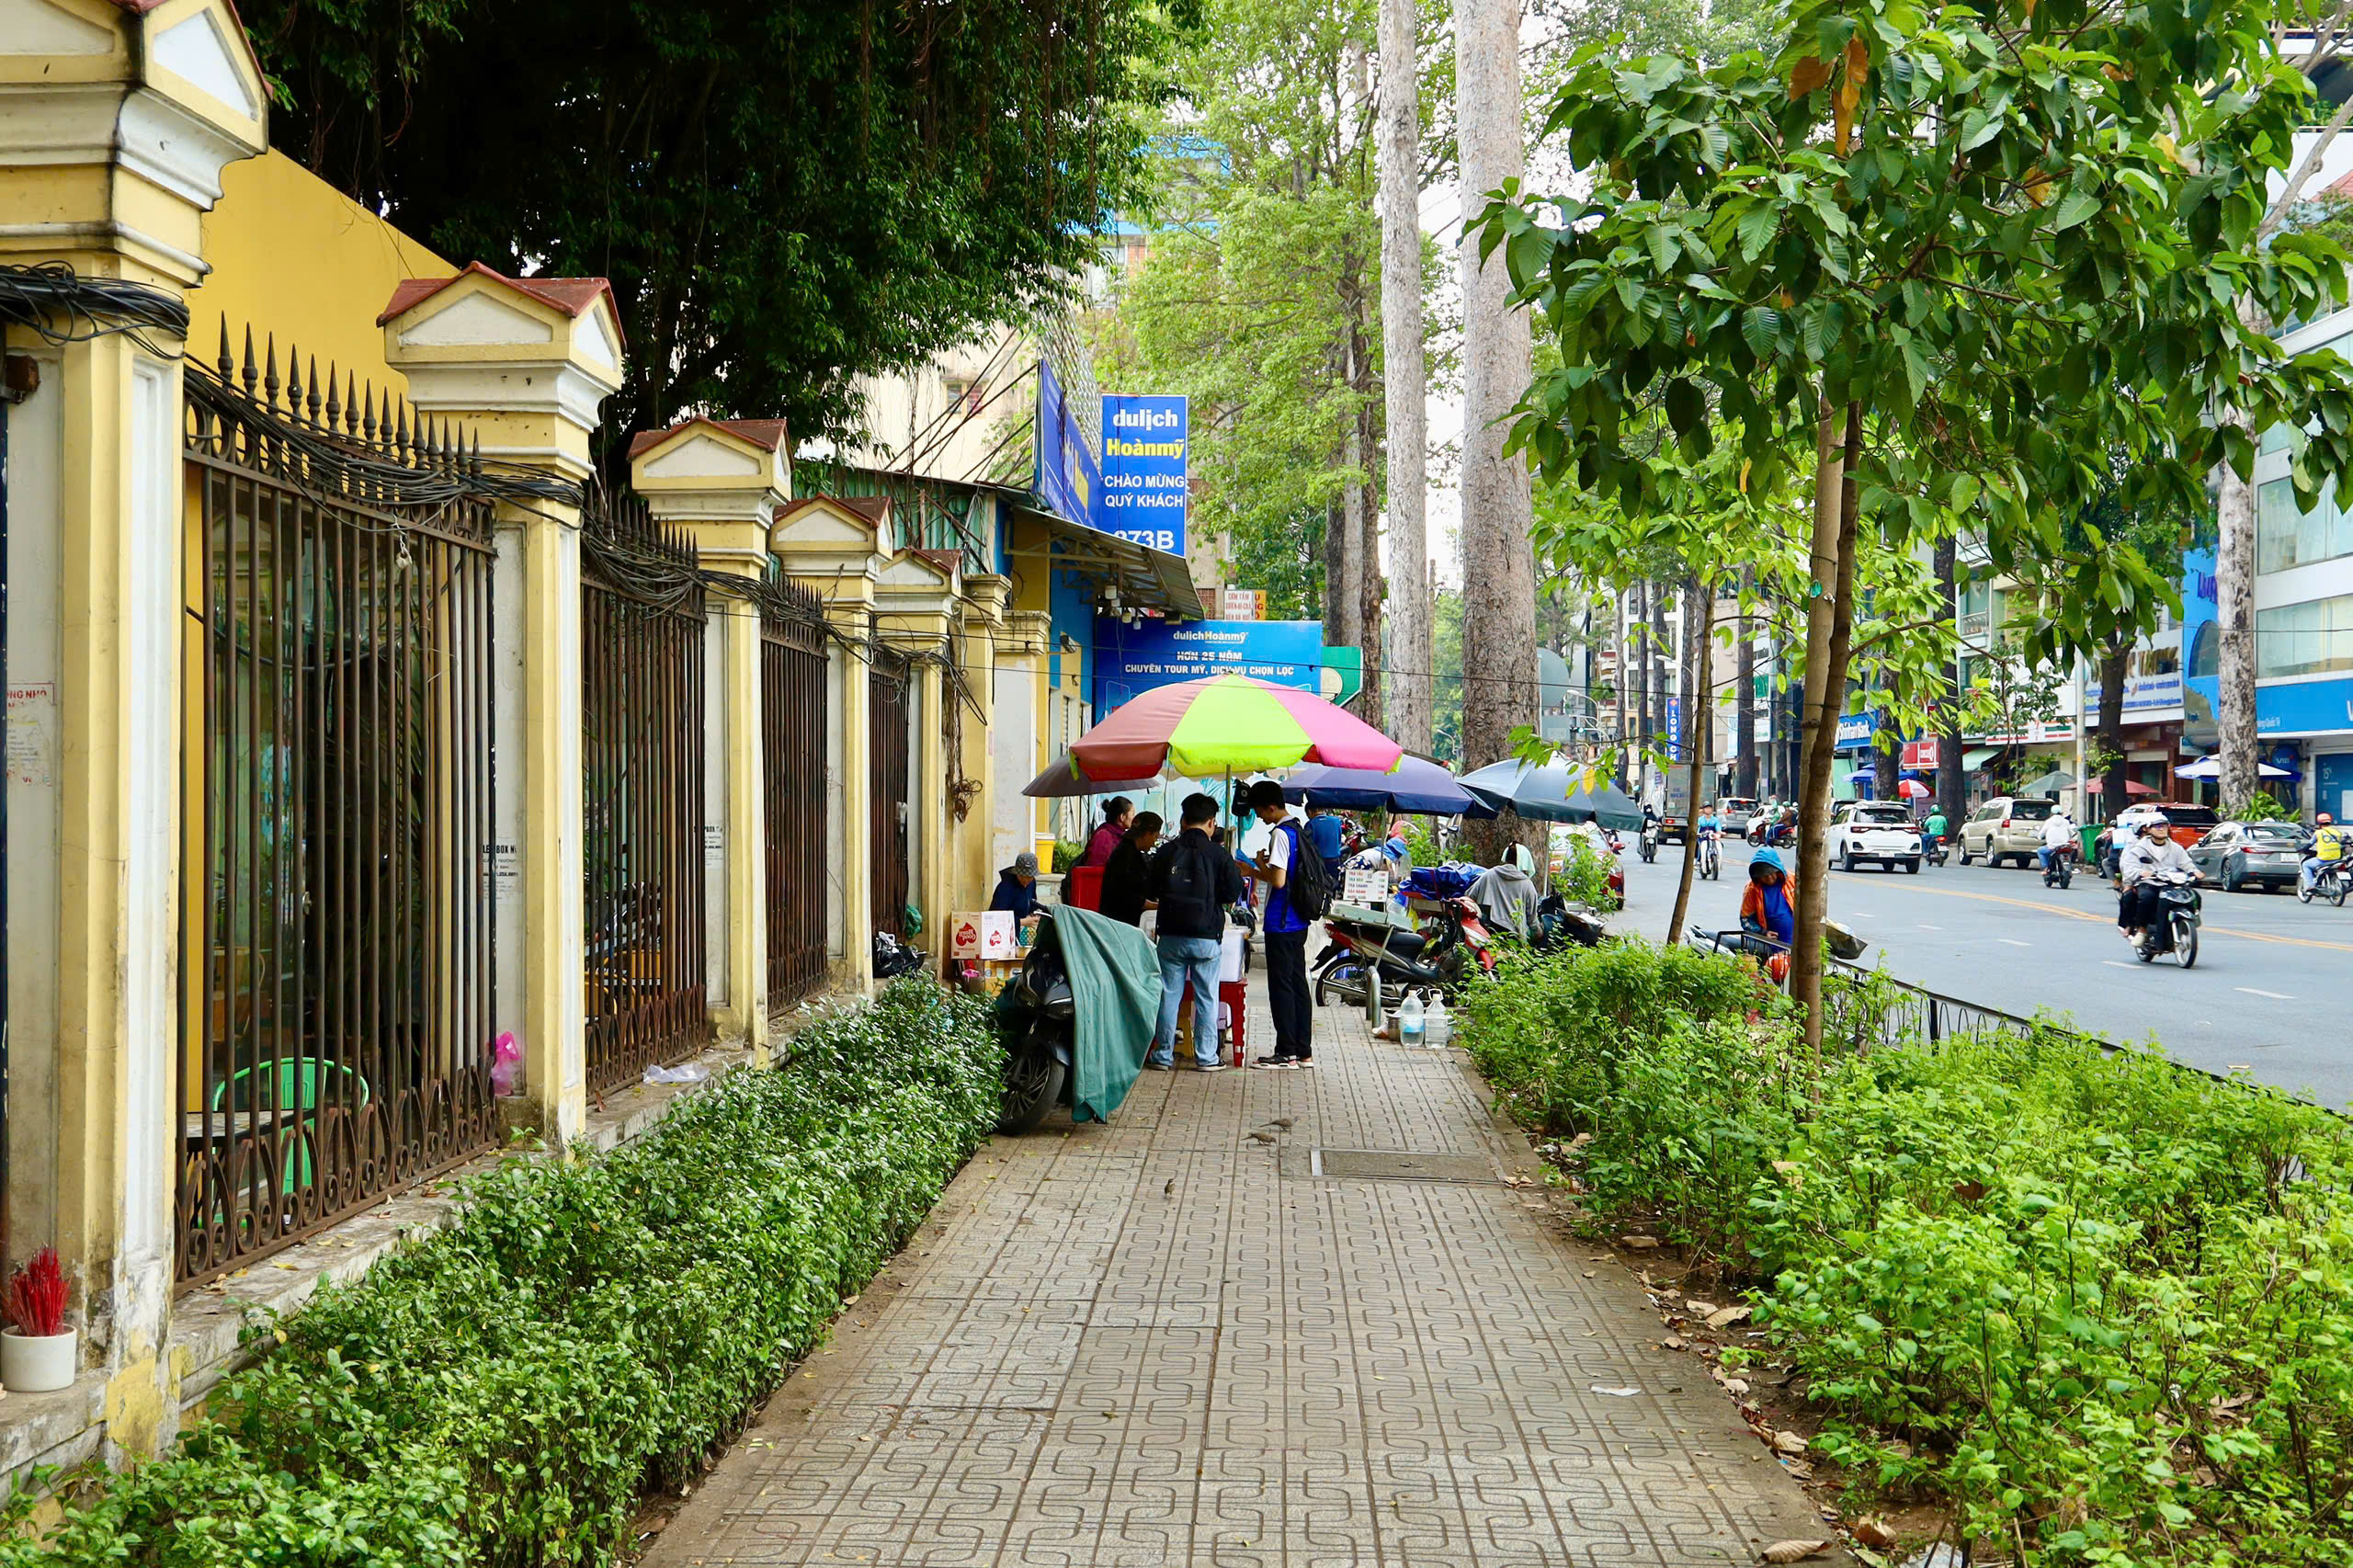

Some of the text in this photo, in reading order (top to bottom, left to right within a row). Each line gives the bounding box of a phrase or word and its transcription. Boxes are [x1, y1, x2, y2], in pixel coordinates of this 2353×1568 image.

[1113, 409, 1178, 431] dulịch
[1107, 437, 1185, 460] Hoànmỹ
[1105, 472, 1185, 488] CHÀO MỪNG
[1105, 492, 1184, 507] QUÝ KHÁCH
[1176, 650, 1243, 662] HƠN 25 NĂM
[1124, 664, 1162, 674] CHUYÊN
[1164, 665, 1189, 674] TOUR
[1249, 666, 1274, 676] CHỌN
[1276, 666, 1295, 677] LỌC
